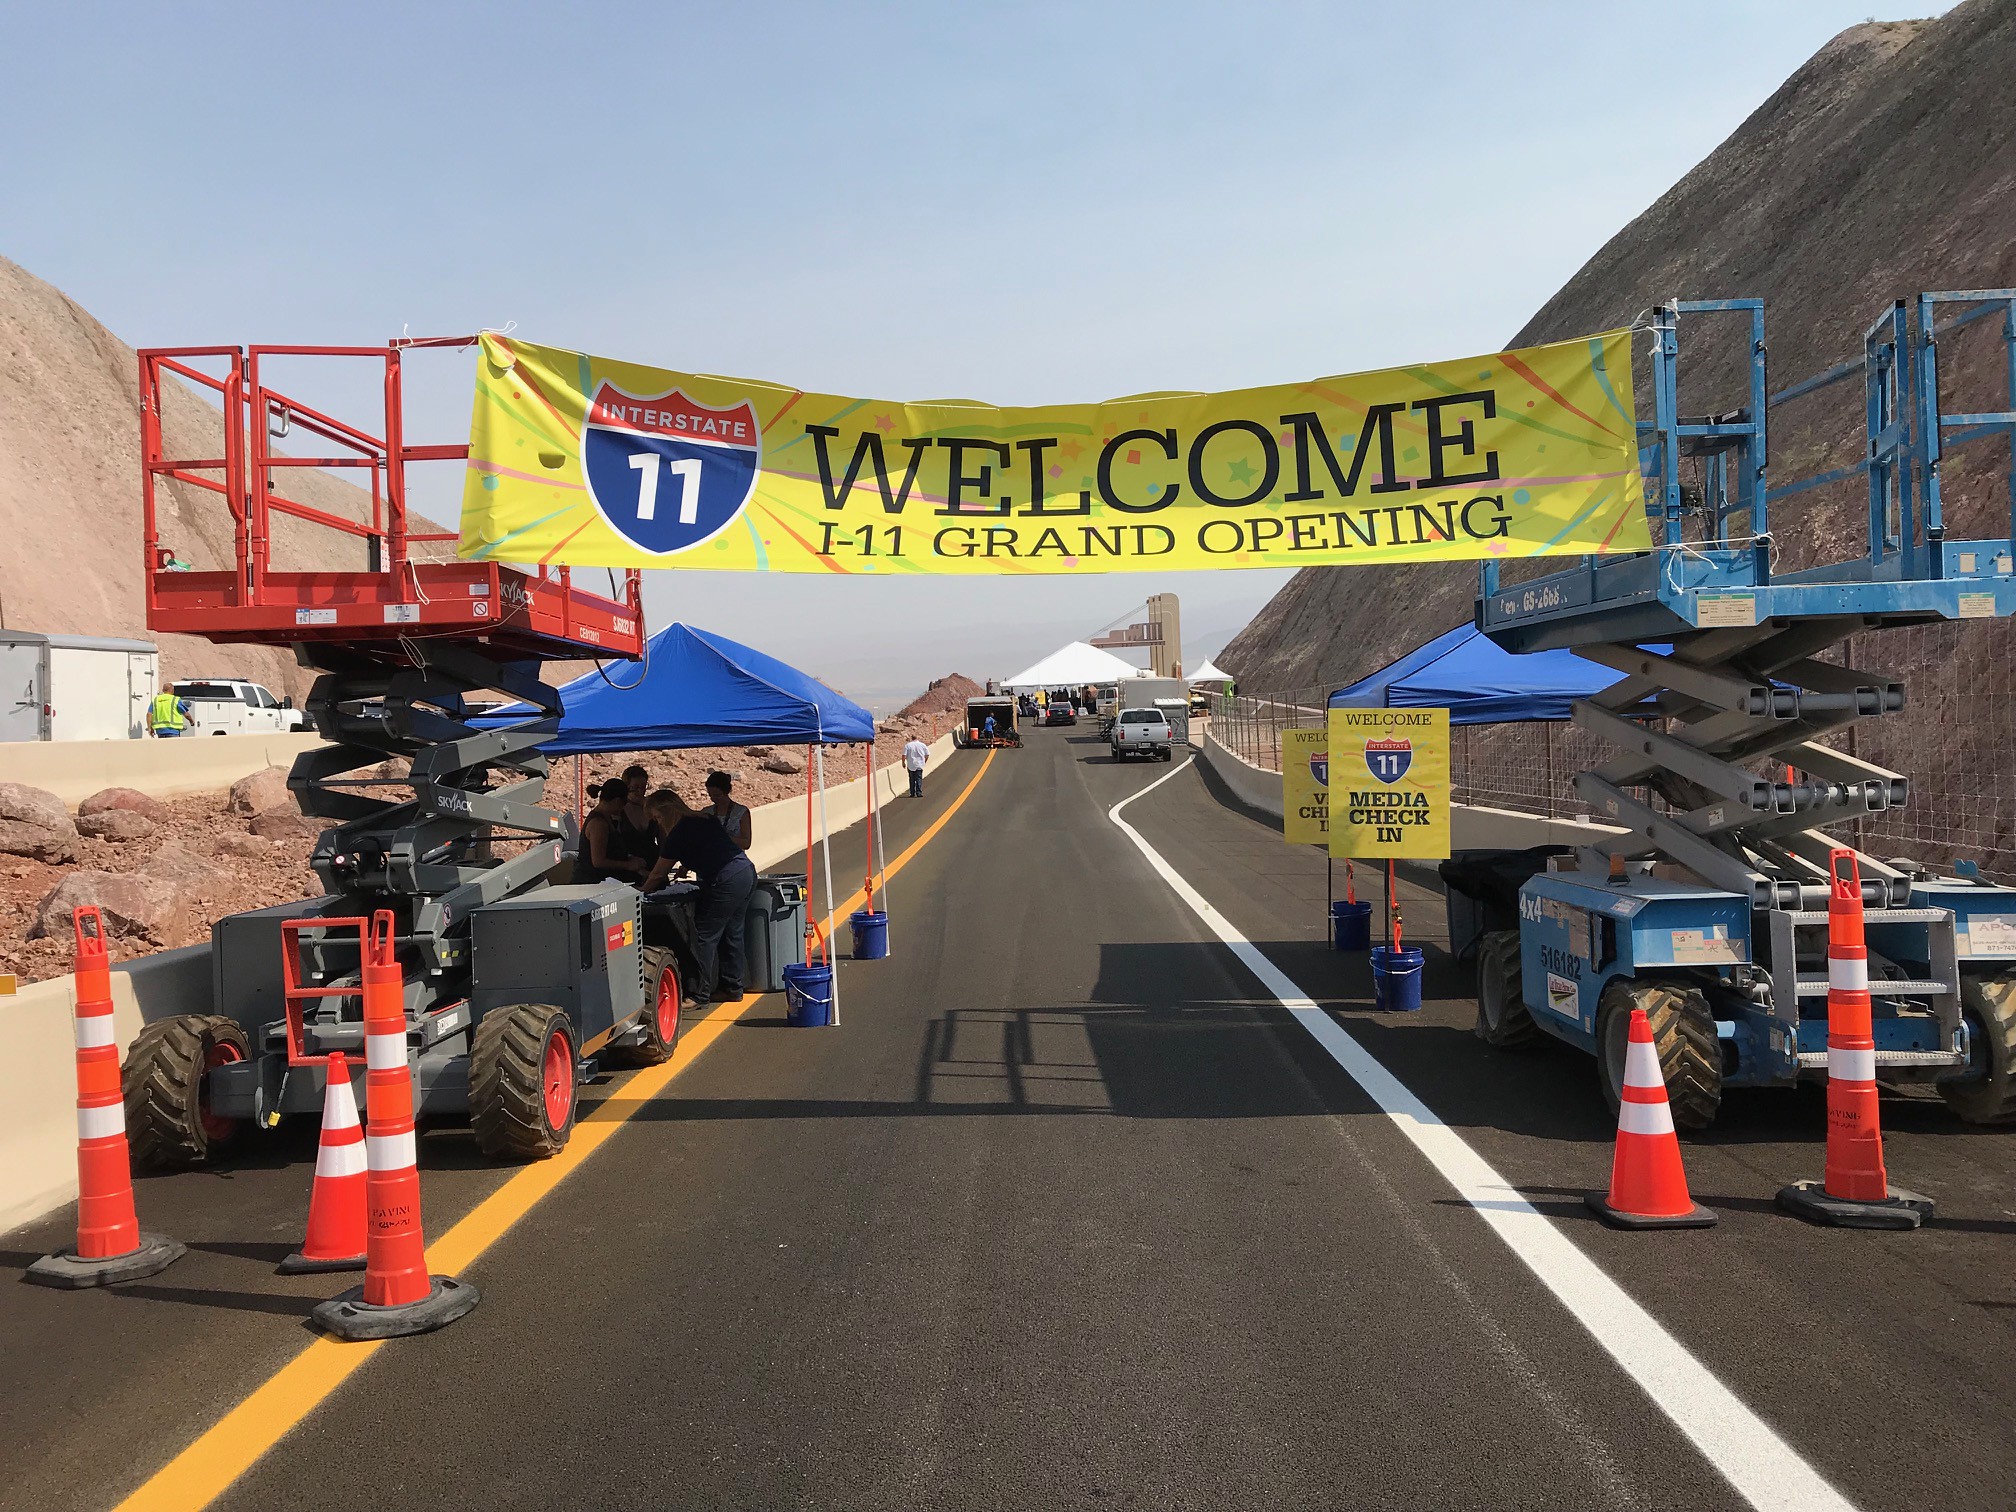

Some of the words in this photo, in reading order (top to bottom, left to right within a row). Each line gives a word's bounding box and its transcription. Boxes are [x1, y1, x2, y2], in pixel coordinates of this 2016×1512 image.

[602, 402, 747, 438] INTERSTATE
[805, 389, 1500, 518] WELCOME
[628, 452, 703, 525] 11
[815, 521, 906, 557] I-11
[932, 523, 1176, 558] GRAND
[1197, 495, 1513, 554] OPENING
[500, 578, 536, 606] KYJACK
[1346, 713, 1432, 726] WELCOME
[1295, 732, 1328, 743] WELC
[1319, 764, 1328, 779] 1
[1377, 754, 1398, 775] 11
[437, 793, 472, 812] SKYJACK
[1349, 791, 1430, 807] MEDIA
[1349, 809, 1431, 826] CHECK
[1376, 827, 1403, 843] IN
[1979, 923, 2016, 931] APC
[1541, 944, 1581, 980] 516182
[372, 1205, 410, 1217] PAVIN
